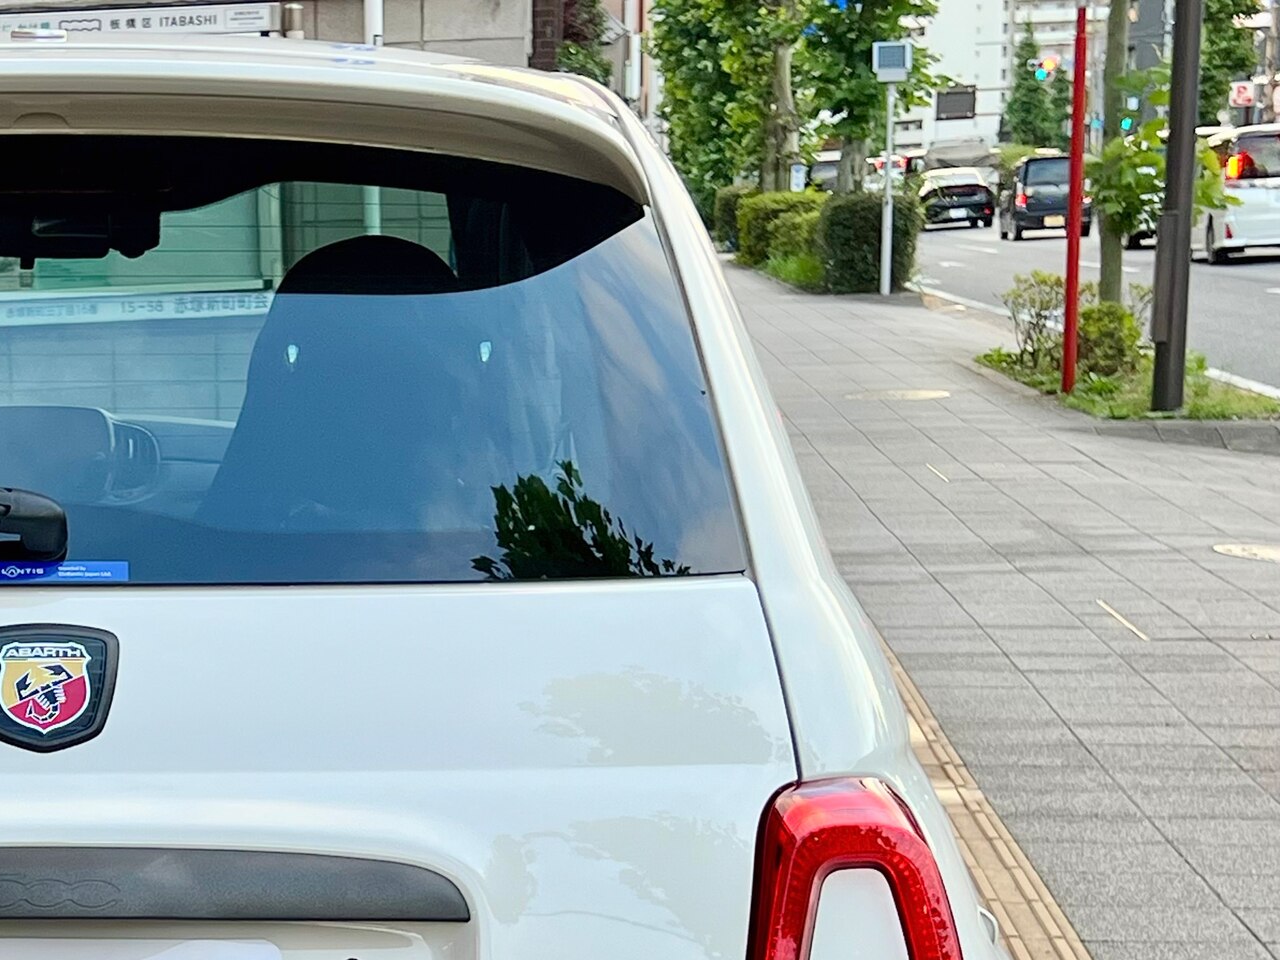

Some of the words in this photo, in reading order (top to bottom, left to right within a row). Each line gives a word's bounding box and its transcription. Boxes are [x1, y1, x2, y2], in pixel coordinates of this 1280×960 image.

[110, 17, 151, 30] 板橋区
[159, 14, 217, 28] ITABASHI
[5, 646, 81, 658] ABARTH
